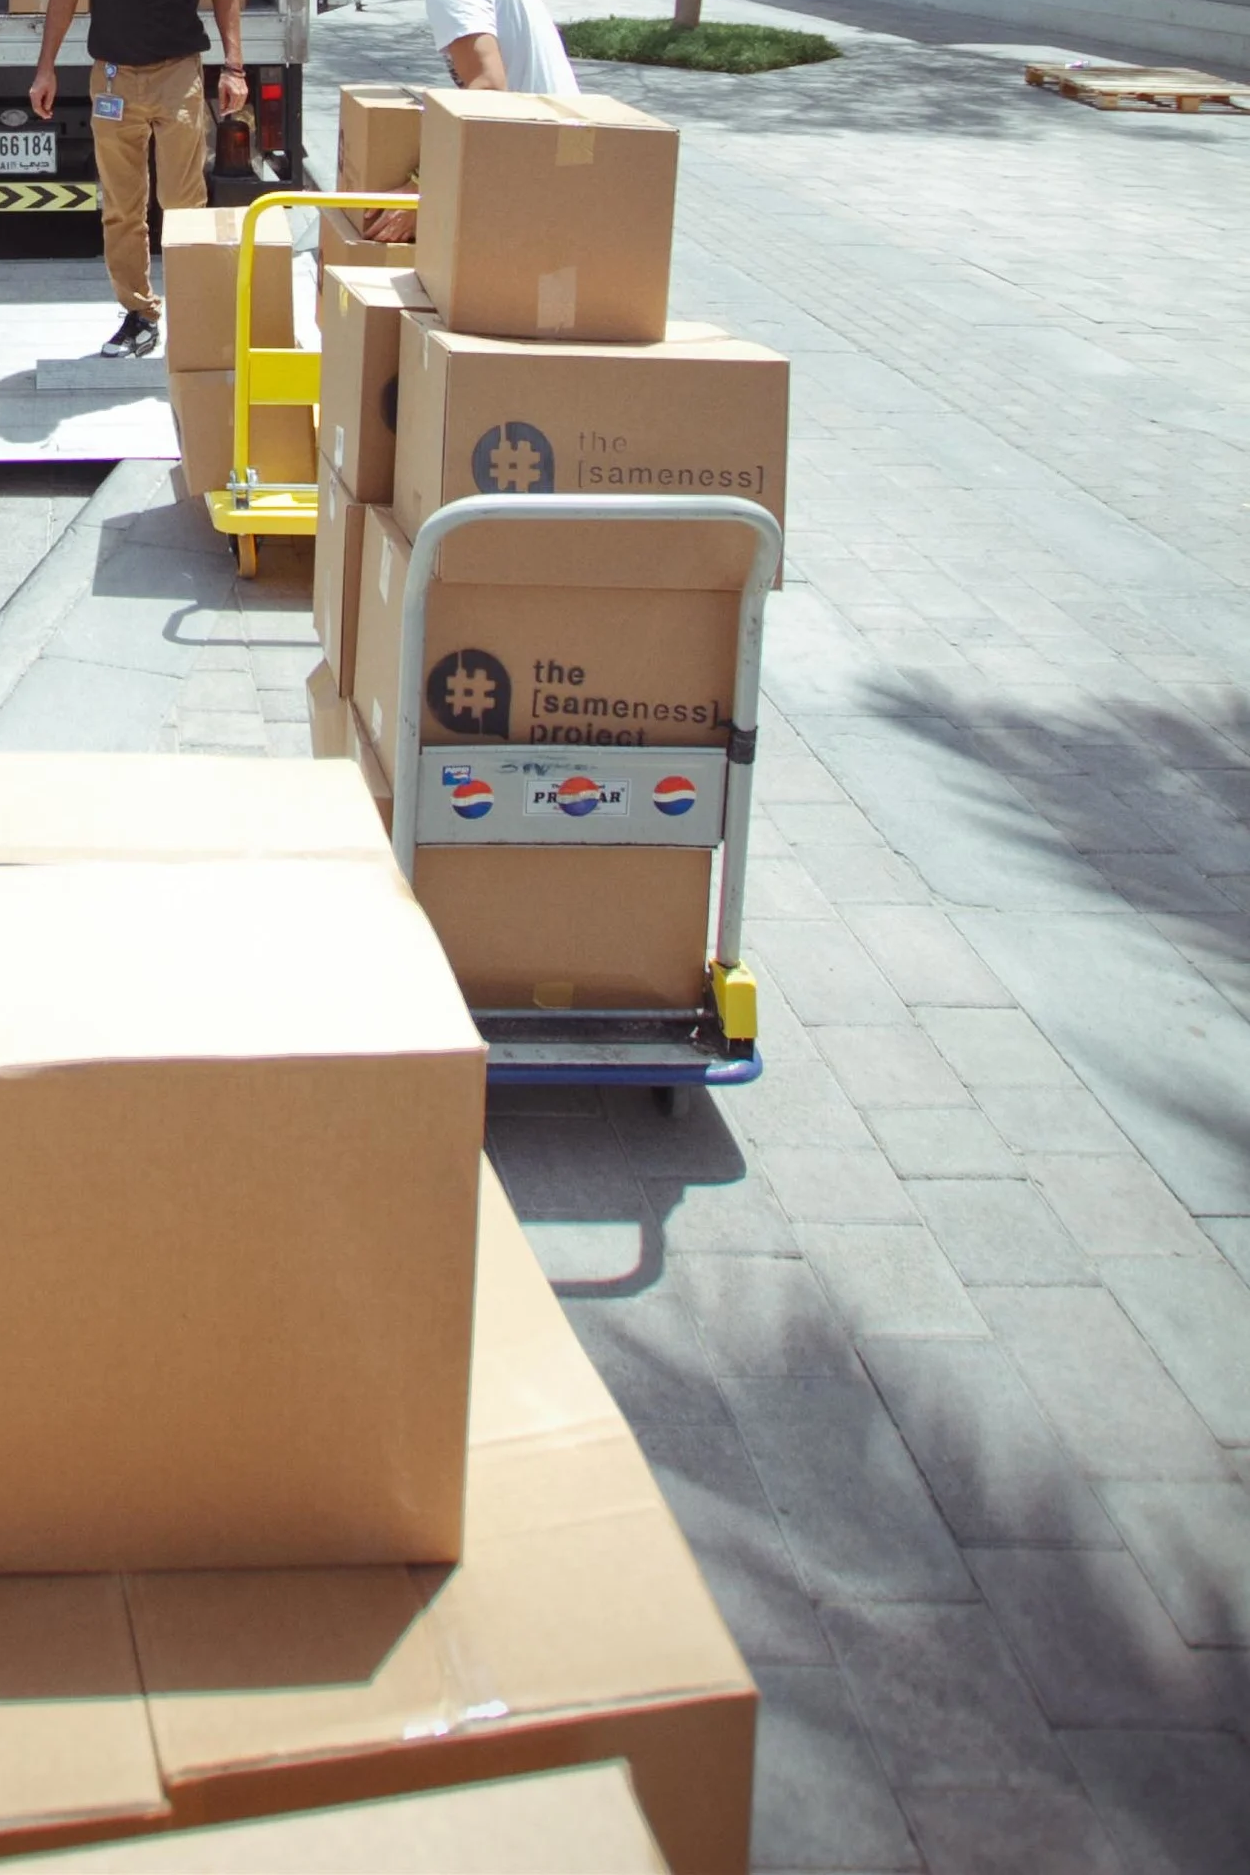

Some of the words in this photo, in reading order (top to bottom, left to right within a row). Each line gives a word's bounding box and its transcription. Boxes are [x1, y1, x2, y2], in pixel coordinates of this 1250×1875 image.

[0, 135, 53, 157] 66184
[578, 431, 628, 453] the
[577, 459, 765, 495] [sameness]
[533, 659, 586, 686] the
[530, 688, 721, 731] [sameness]
[532, 791, 621, 804] PRAR
